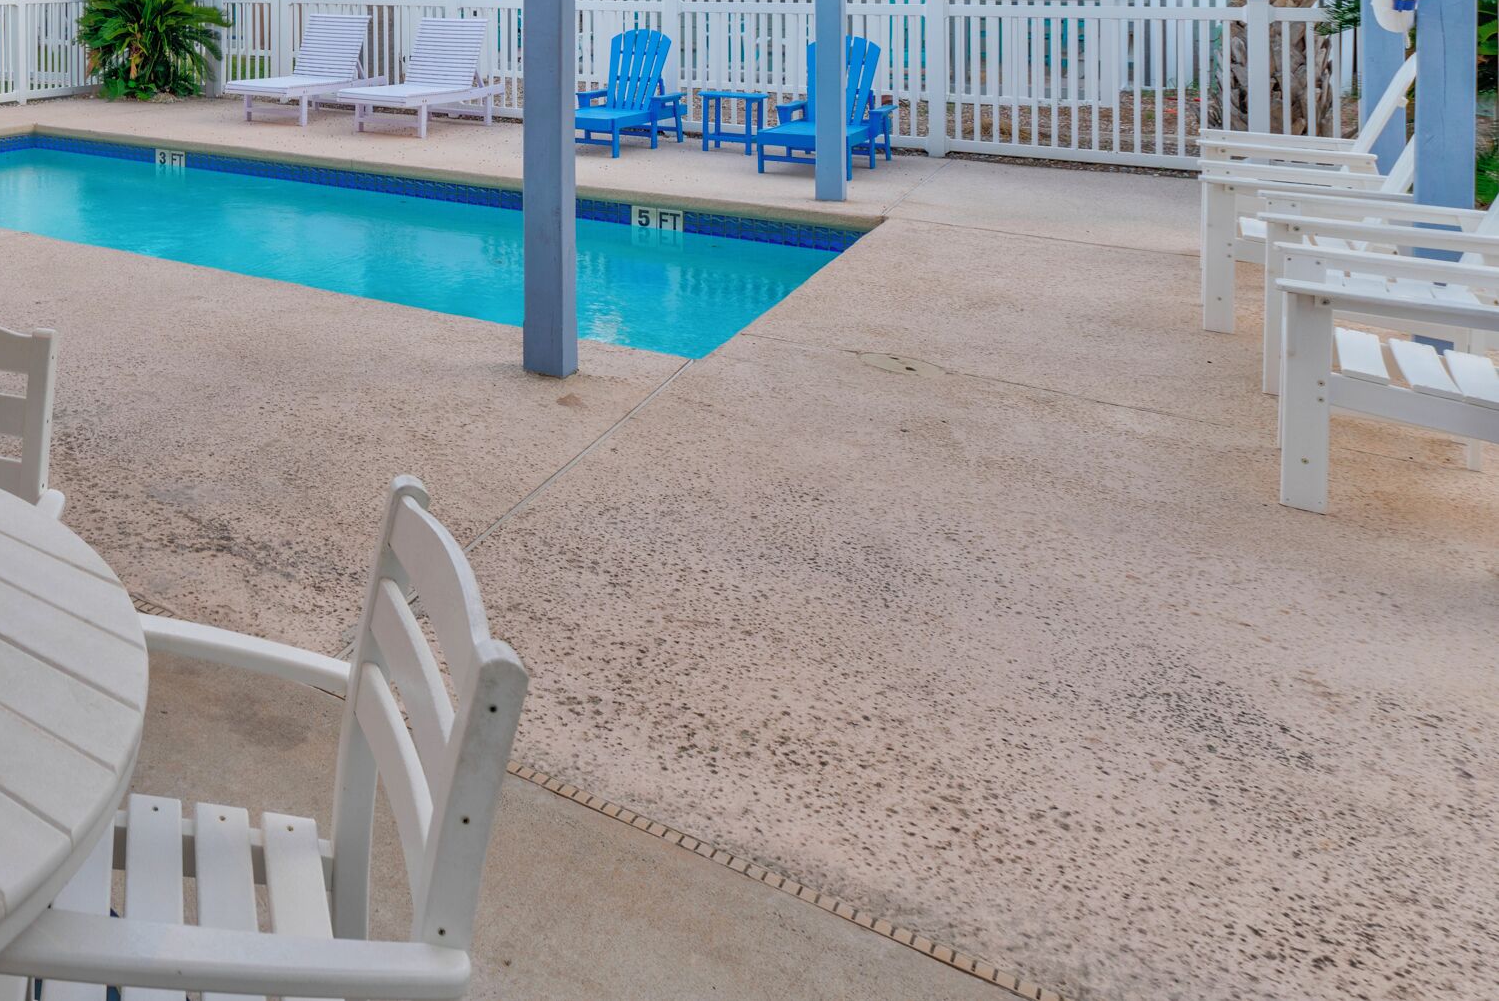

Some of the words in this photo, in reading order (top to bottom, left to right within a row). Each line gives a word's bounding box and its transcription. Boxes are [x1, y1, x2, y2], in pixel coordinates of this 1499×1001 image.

[159, 151, 166, 165] 3
[171, 152, 184, 167] FT
[638, 208, 650, 227] 5
[659, 211, 681, 231] FT
